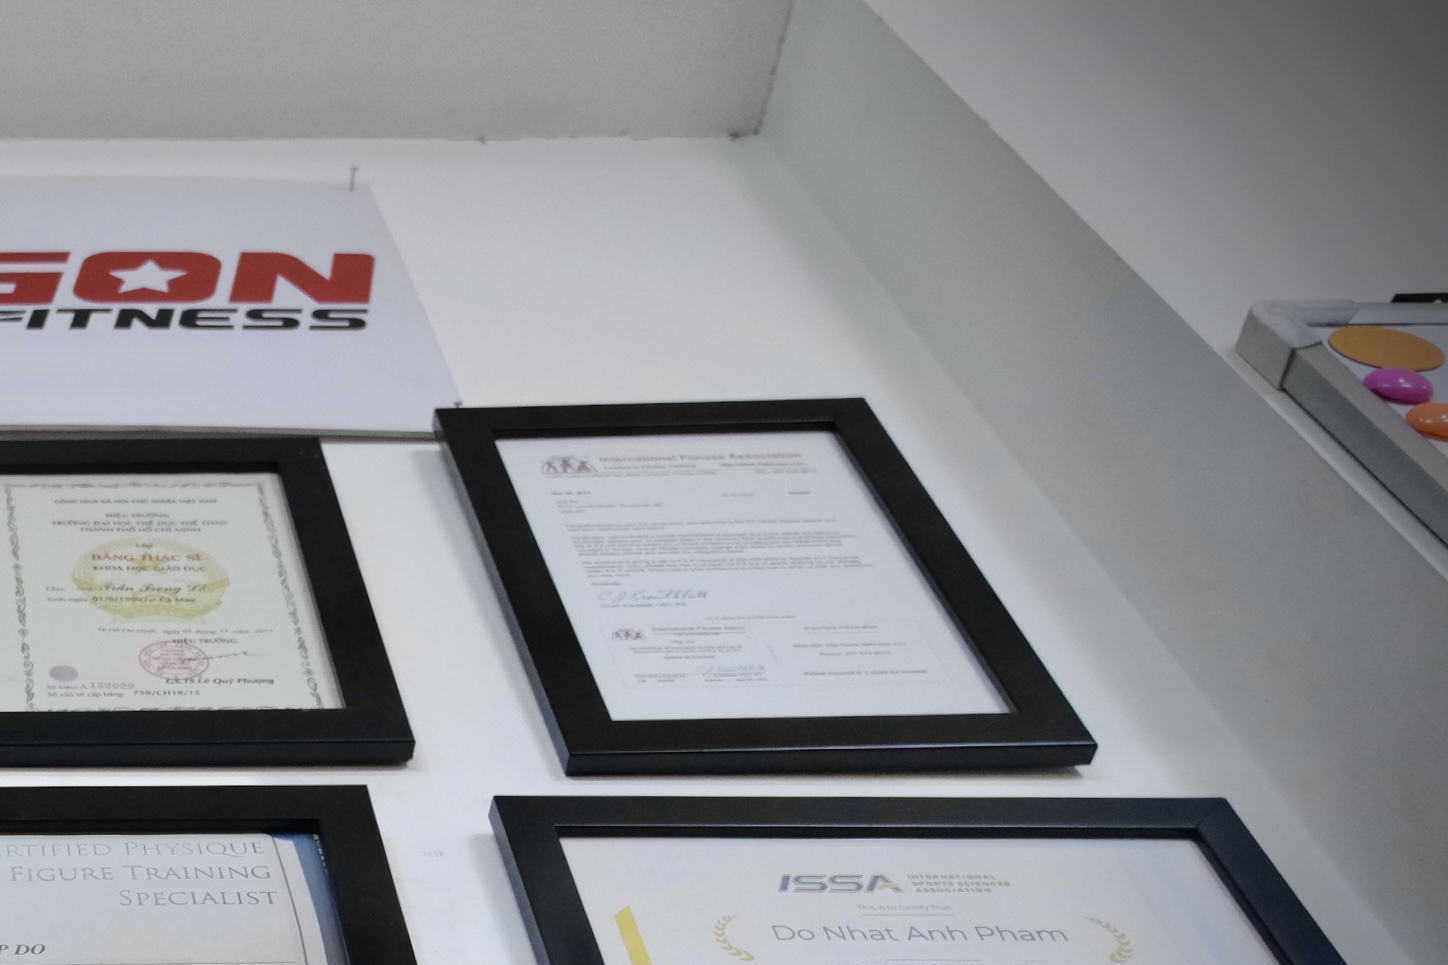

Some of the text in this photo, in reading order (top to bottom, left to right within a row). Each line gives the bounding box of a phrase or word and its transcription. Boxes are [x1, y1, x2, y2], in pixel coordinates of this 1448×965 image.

[599, 455, 677, 463] International
[728, 452, 803, 460] Association
[124, 841, 265, 858] PHYSIQUE
[10, 866, 114, 882] FIGURE
[122, 865, 271, 881] TRAINING
[777, 873, 903, 893] ISSA
[119, 889, 278, 906] SPECIALIST
[771, 924, 1069, 942] Do Nhat Anh Pham
[14, 943, 46, 956] DO
